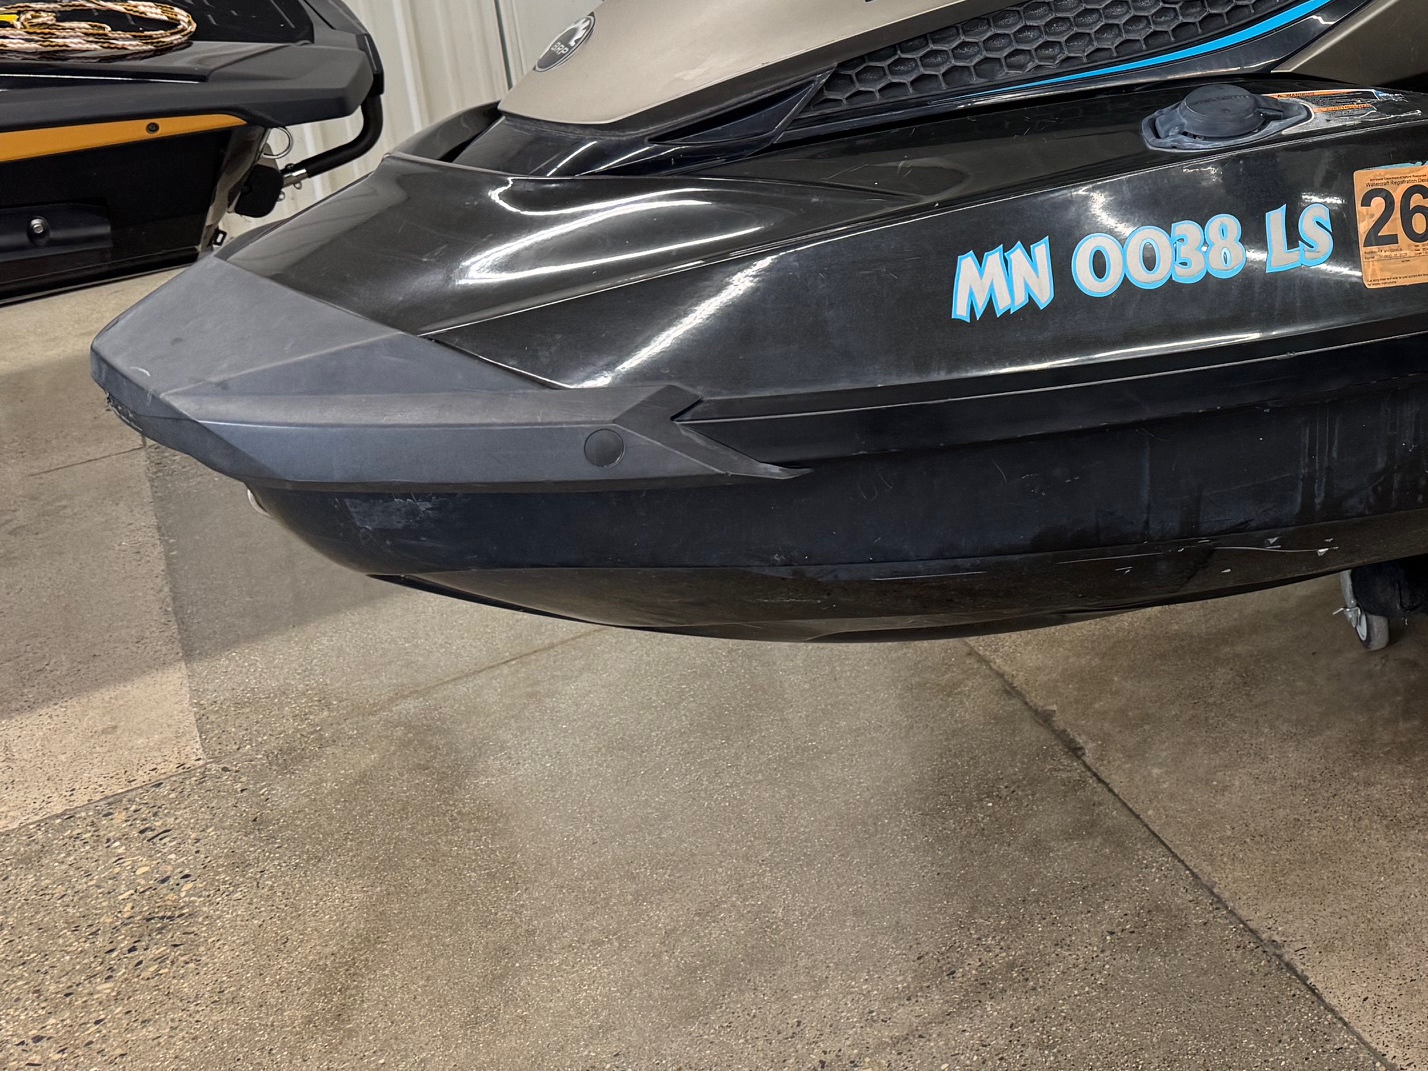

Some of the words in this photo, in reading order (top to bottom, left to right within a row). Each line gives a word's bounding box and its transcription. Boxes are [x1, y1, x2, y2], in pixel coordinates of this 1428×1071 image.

[951, 235, 1055, 323] MN
[1071, 213, 1247, 297] 0038
[1266, 203, 1334, 273] LS
